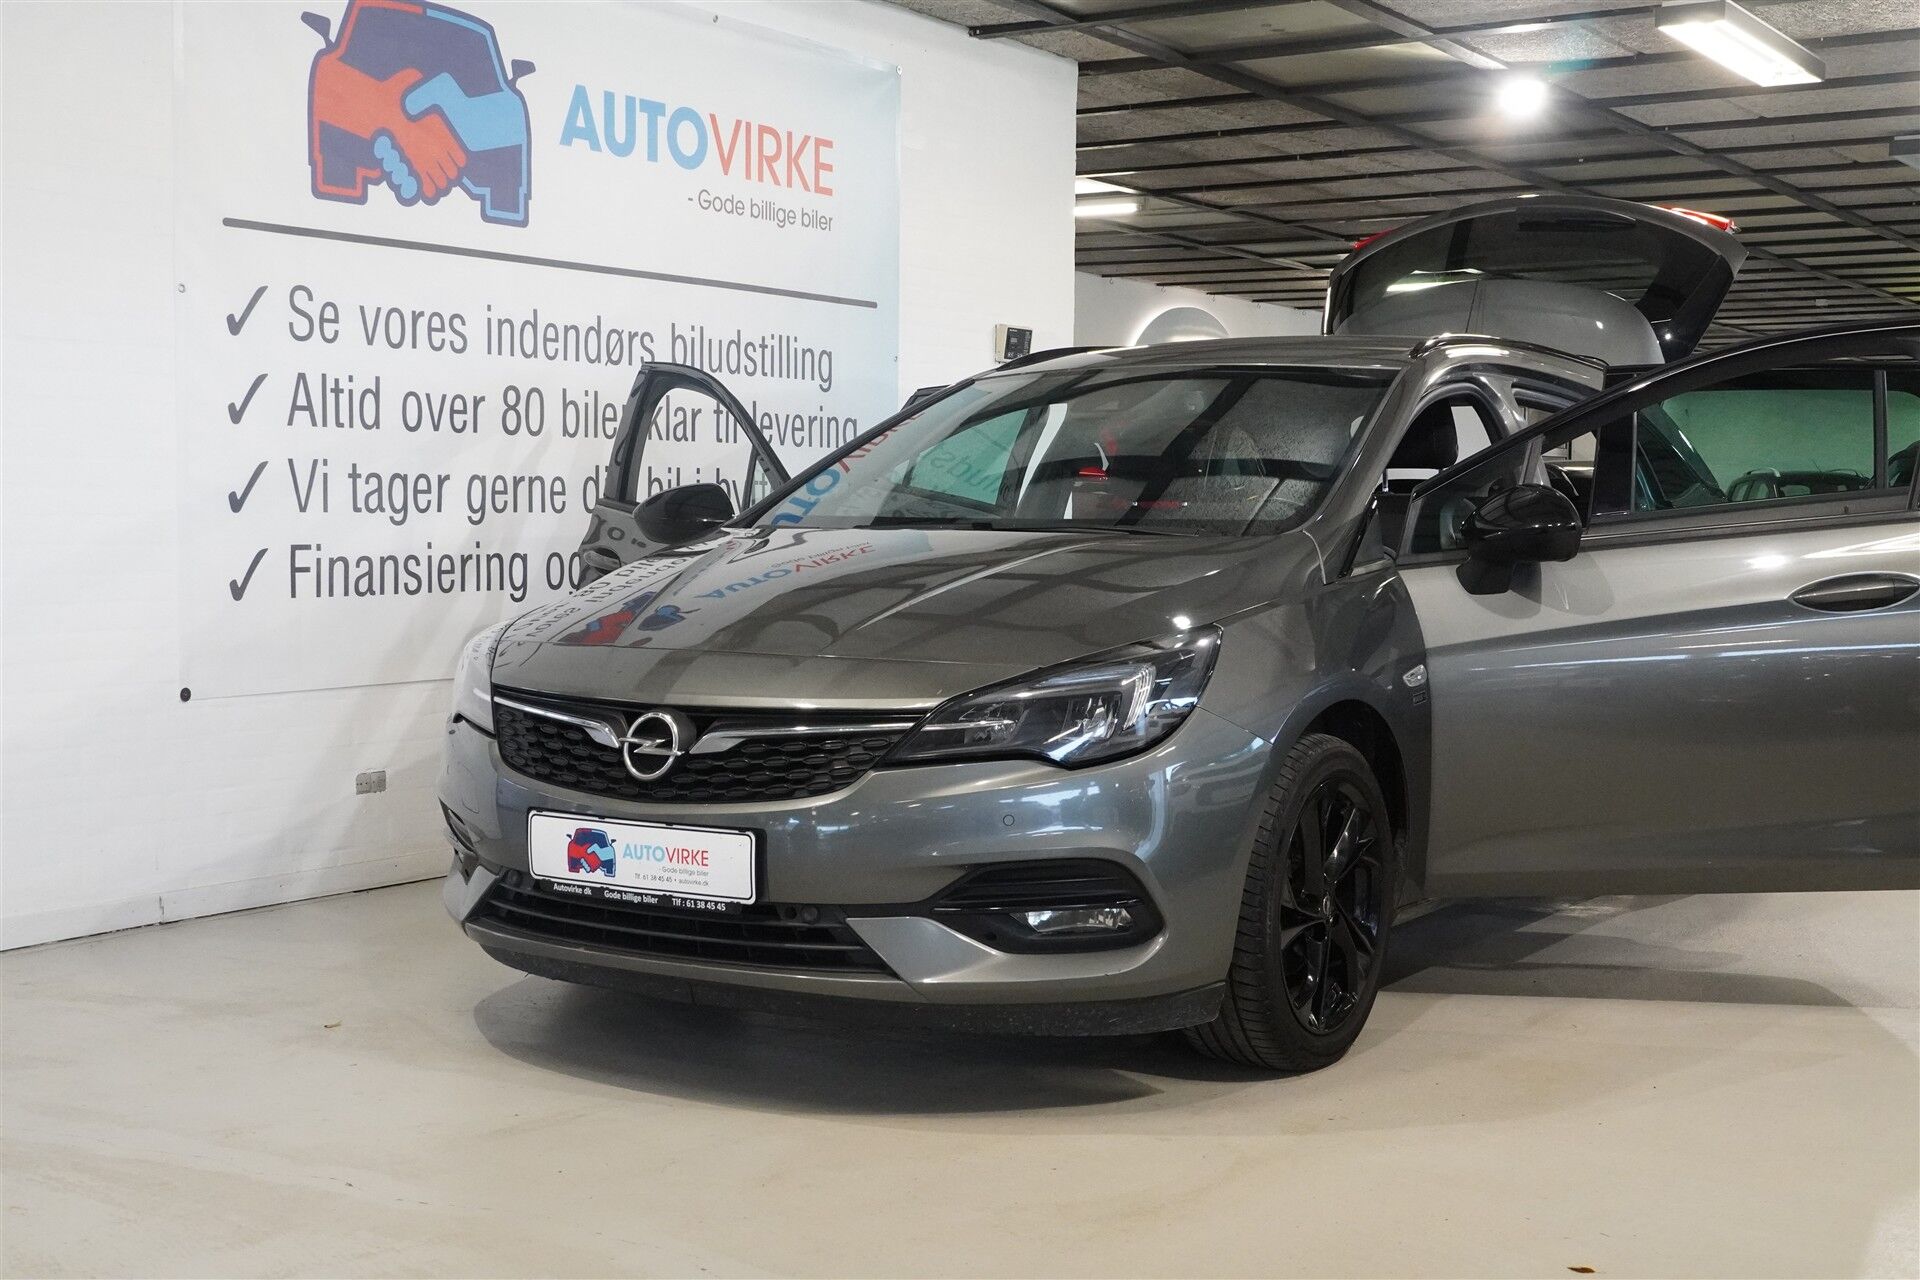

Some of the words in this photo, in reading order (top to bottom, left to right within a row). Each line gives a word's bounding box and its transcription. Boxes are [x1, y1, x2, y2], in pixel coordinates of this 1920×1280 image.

[559, 83, 834, 197] AUTOVIRKE
[697, 188, 746, 217] Gode
[749, 197, 797, 229] billige
[800, 207, 834, 232] biler
[288, 284, 341, 343] Se
[359, 304, 468, 354] vores
[486, 303, 656, 366] indendørs
[670, 322, 833, 392] biludstilling
[287, 372, 381, 430] Altid
[401, 390, 486, 433] over
[500, 384, 545, 437] 80
[561, 387, 626, 439] bile
[649, 394, 703, 442] klar
[287, 458, 329, 513] Vi
[348, 463, 450, 526] tager
[467, 473, 566, 526] gerne
[289, 541, 528, 603] Finansiering
[623, 844, 709, 867] AUTOVIRKE
[553, 883, 583, 894] Autovirke
[604, 890, 622, 900] Gode
[622, 893, 643, 904] billige
[643, 895, 659, 904] biler
[686, 899, 695, 908] 61
[696, 901, 706, 910] 38
[706, 901, 716, 911] 45
[716, 902, 726, 912] 45
